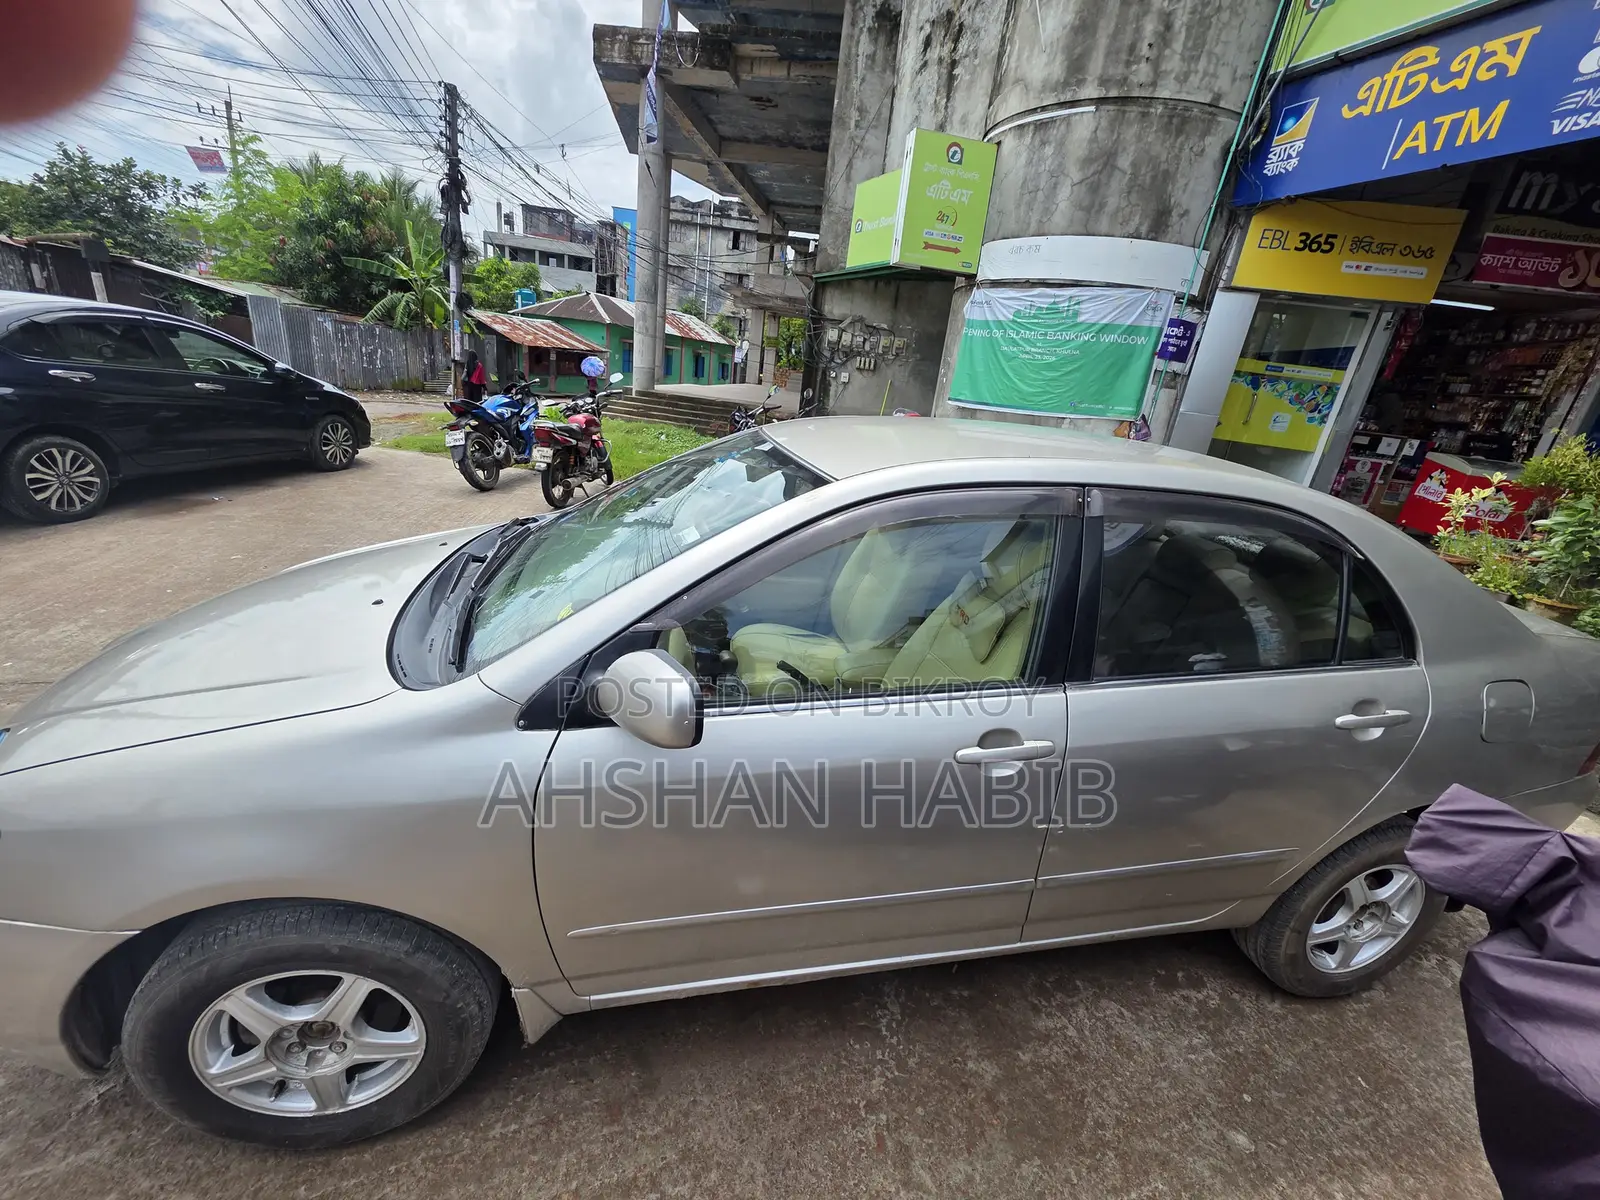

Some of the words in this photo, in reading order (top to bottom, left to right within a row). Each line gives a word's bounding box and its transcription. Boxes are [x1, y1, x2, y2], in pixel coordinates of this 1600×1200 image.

[1392, 99, 1511, 161] ATM
[1550, 112, 1600, 135] VISA
[1265, 139, 1306, 164] ব্র্যাক
[1263, 157, 1301, 177] ব্যাংক
[1258, 228, 1291, 251] EBL
[1294, 232, 1338, 254] 365
[1349, 235, 1398, 257] ইবিএল
[1400, 244, 1435, 260] ৩৬৫
[1480, 253, 1517, 269] ক্যাশ
[1518, 256, 1562, 273] আউট
[992, 329, 1004, 338] OF
[1005, 329, 1045, 340] ISLAMIC
[1046, 331, 1097, 342] BANKING
[1100, 333, 1150, 345] WINDOW
